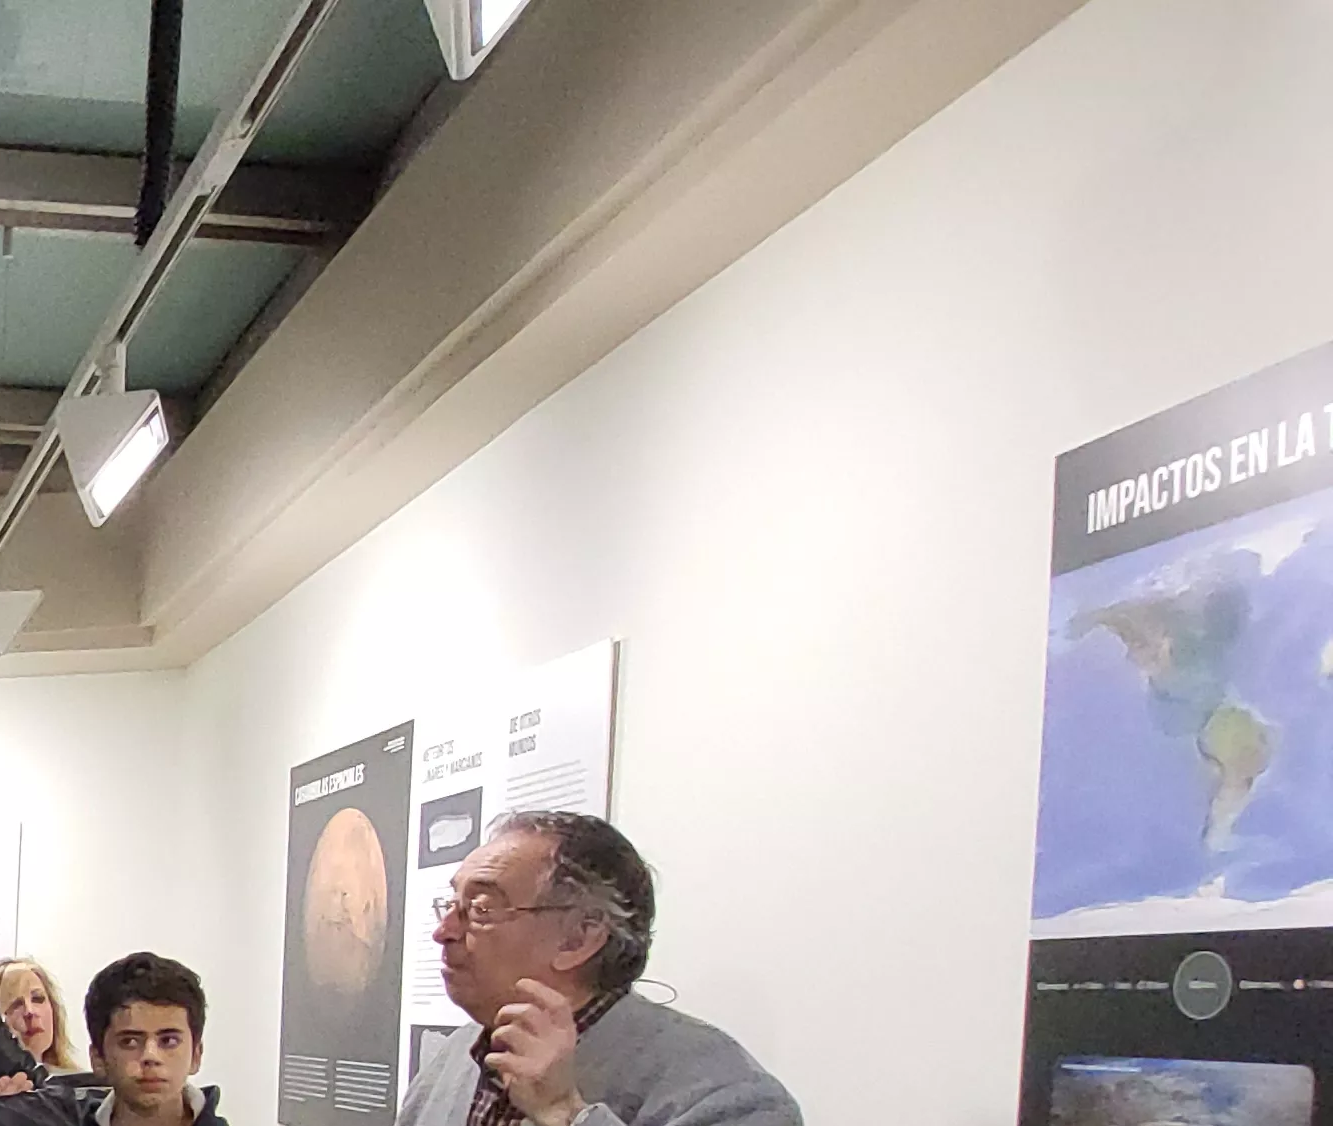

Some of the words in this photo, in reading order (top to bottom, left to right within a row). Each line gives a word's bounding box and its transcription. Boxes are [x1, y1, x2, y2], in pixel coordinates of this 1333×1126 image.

[1087, 446, 1223, 534] IMPACTOS
[1230, 428, 1269, 484] EN
[1278, 412, 1316, 468] LA
